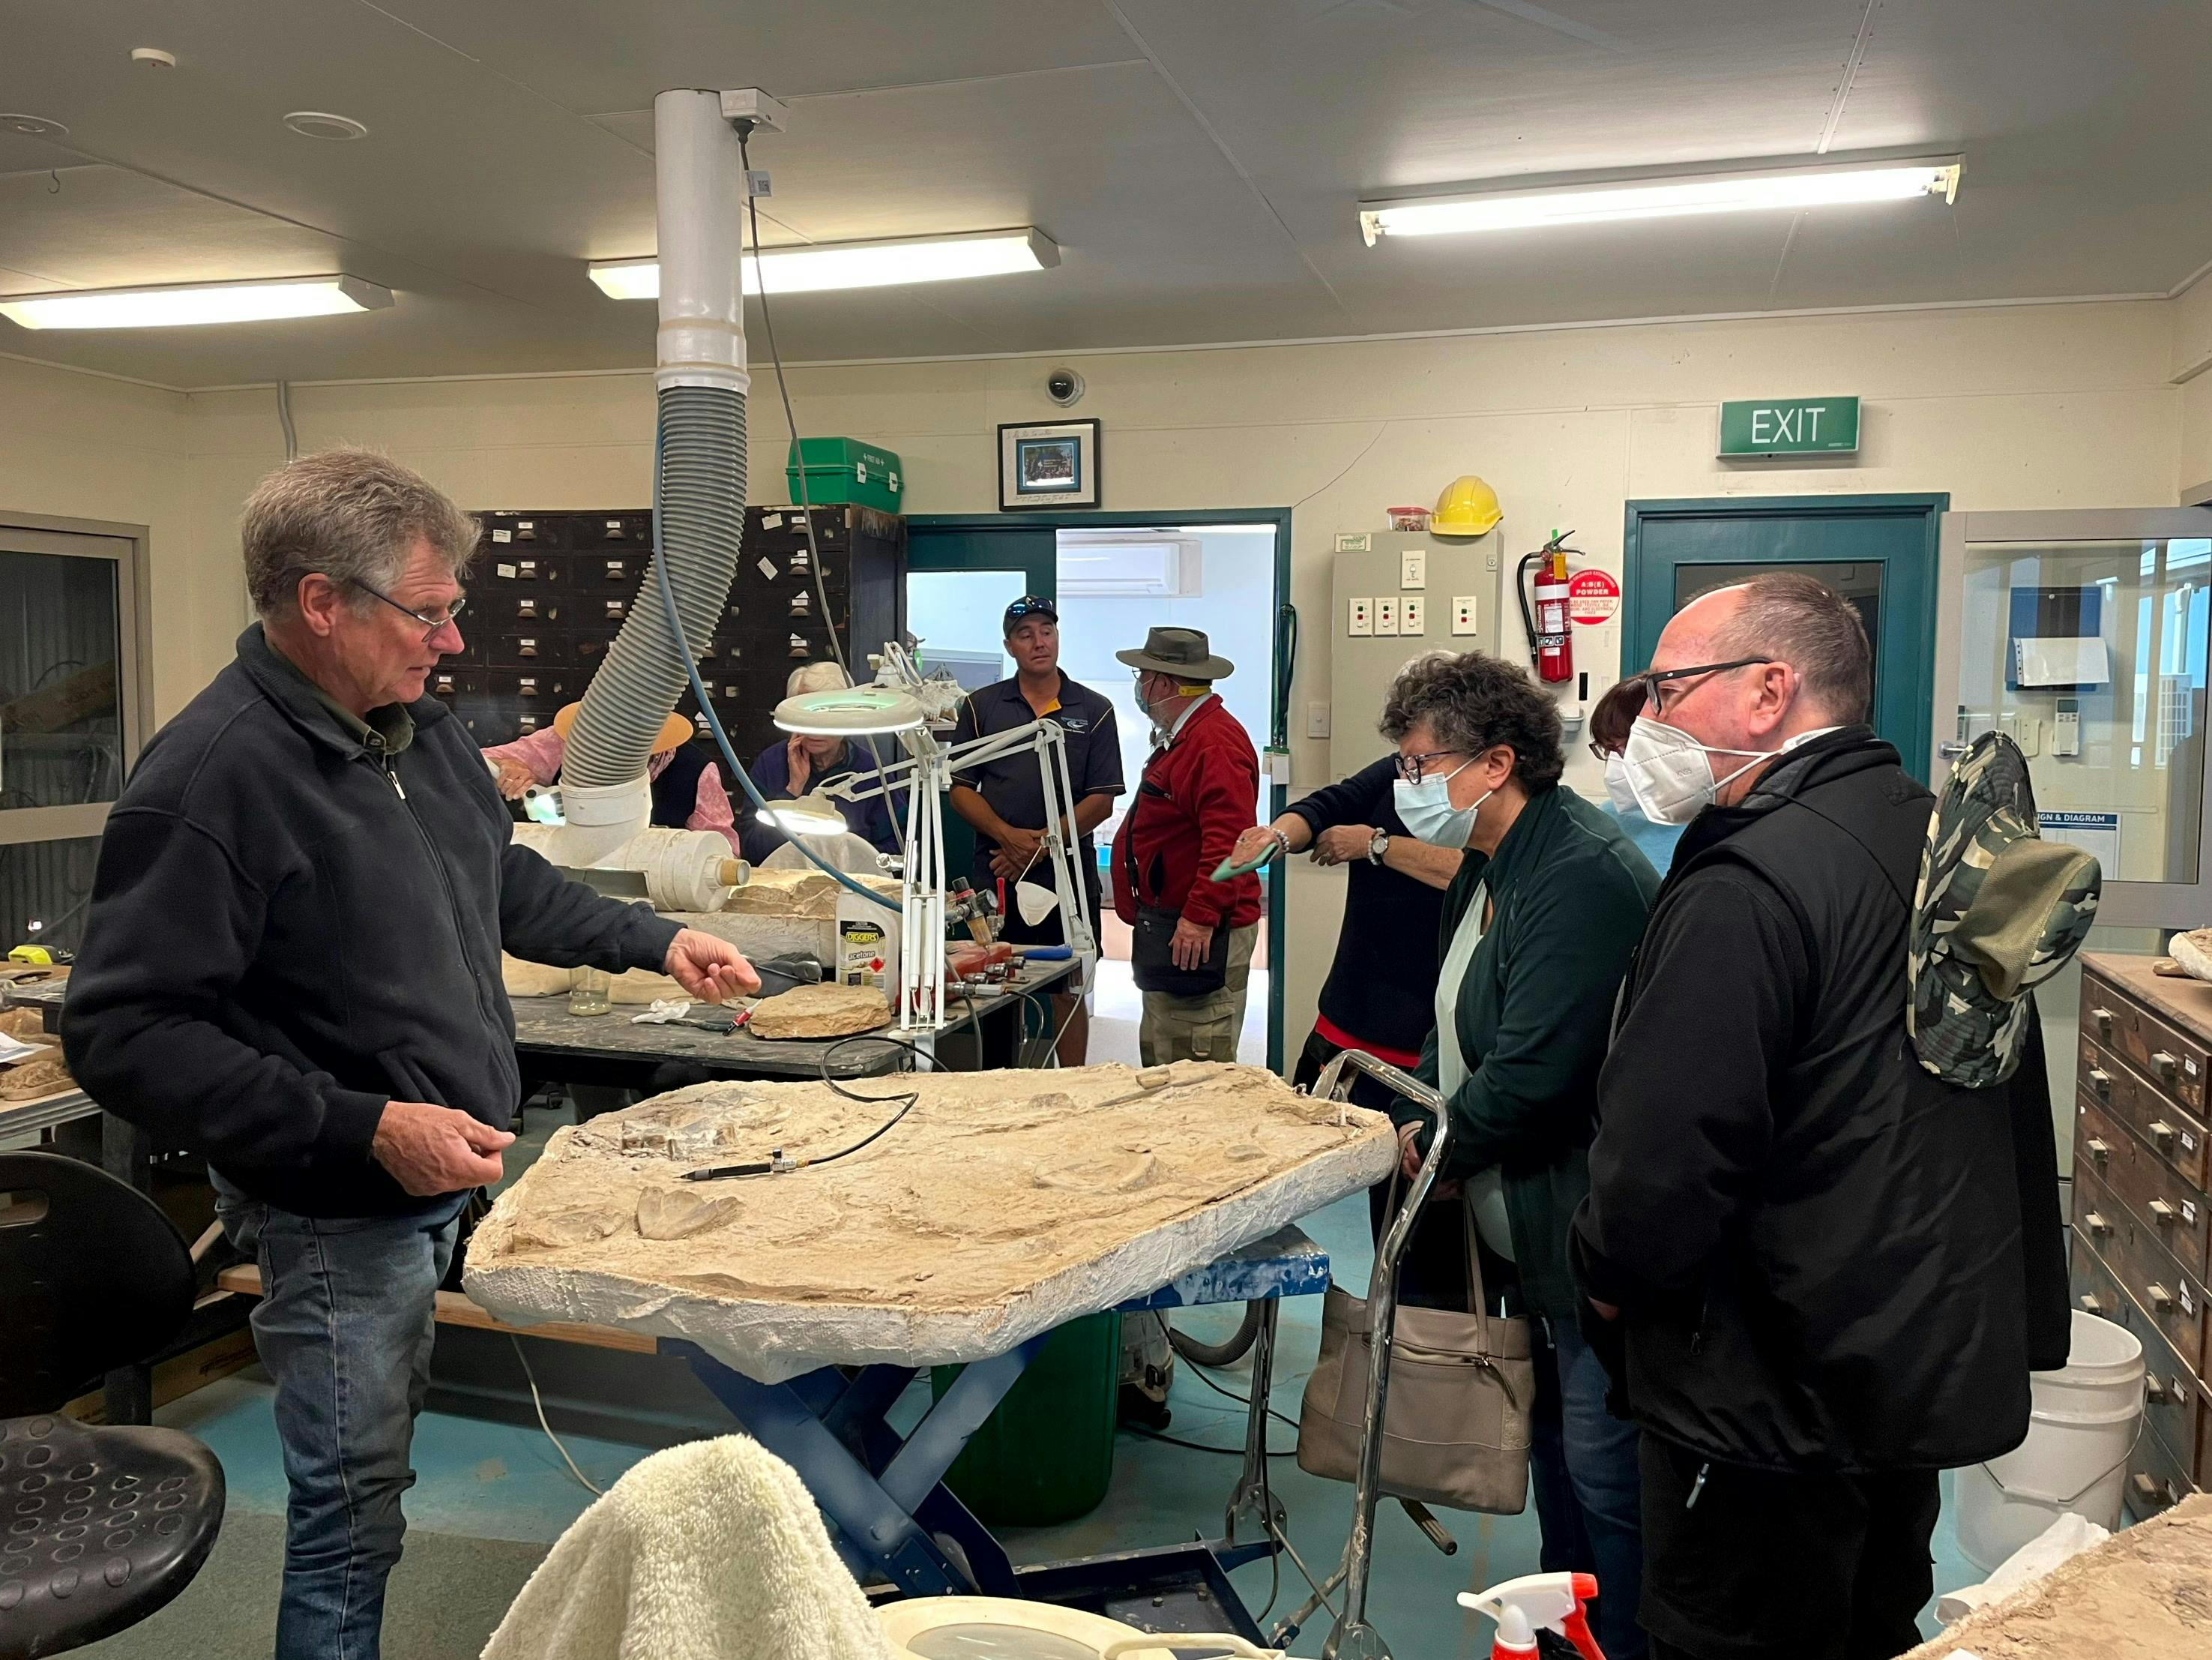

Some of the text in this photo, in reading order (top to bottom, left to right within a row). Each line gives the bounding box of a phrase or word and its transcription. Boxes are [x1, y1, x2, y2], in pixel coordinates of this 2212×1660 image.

[1751, 407, 1826, 444] EXIT
[2064, 814, 2105, 823] DIAGRAM
[849, 951, 876, 960] acetone
